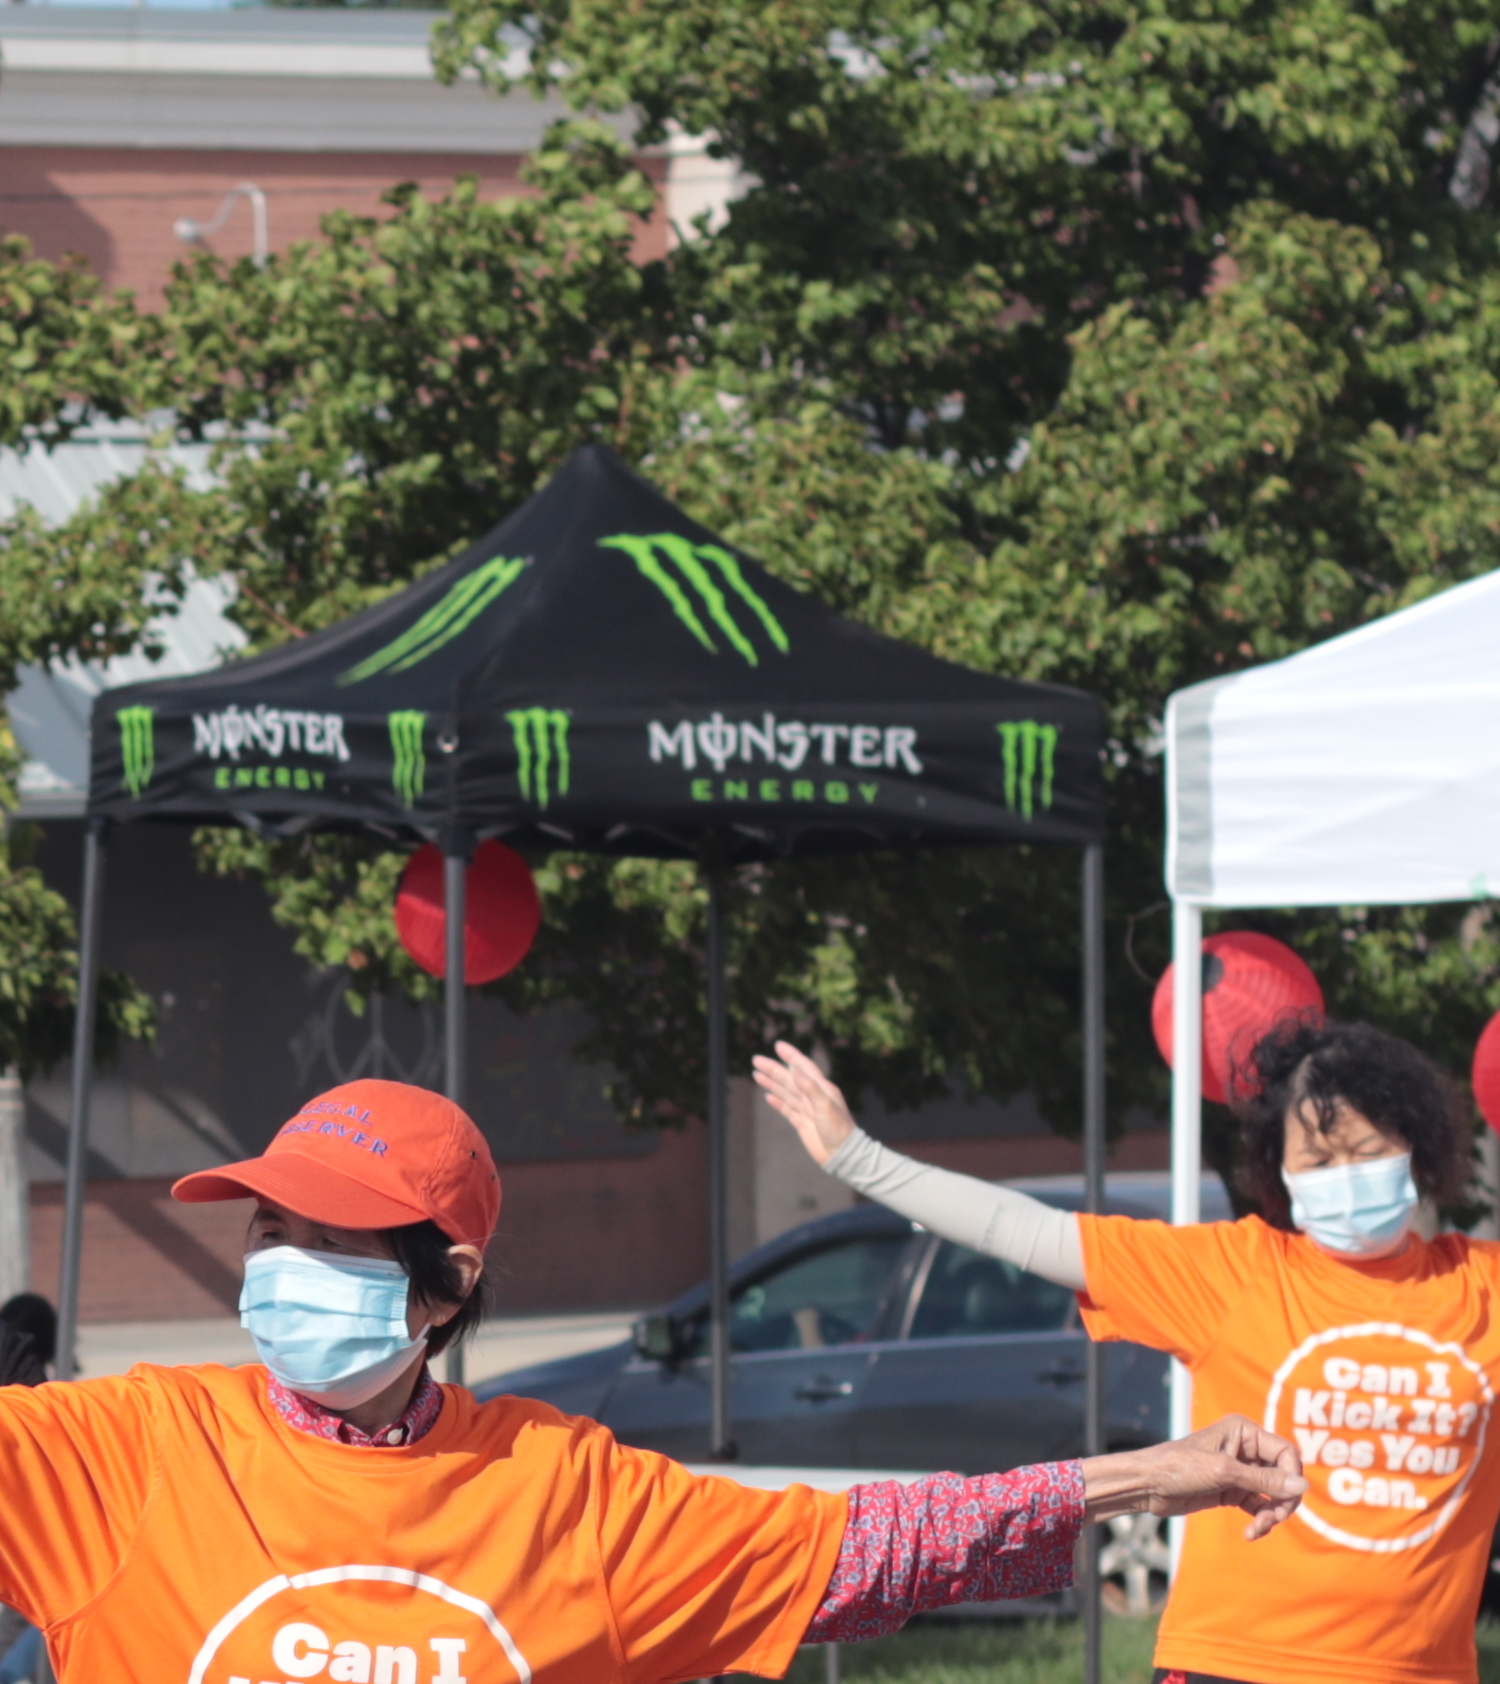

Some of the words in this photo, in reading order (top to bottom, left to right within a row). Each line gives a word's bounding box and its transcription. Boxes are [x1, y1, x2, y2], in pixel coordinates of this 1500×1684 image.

[191, 703, 351, 763] MONSTER
[648, 711, 924, 776] MONSTER
[214, 766, 326, 791] ENERGY
[690, 779, 879, 804] ENERGY
[300, 1102, 372, 1126] LEGAL
[1323, 1357, 1418, 1396] Can
[1425, 1362, 1452, 1398] I
[1293, 1388, 1403, 1431] Kick
[1407, 1399, 1478, 1437] It?
[1293, 1427, 1375, 1469] Yes
[1379, 1433, 1460, 1475] You
[1327, 1467, 1428, 1511] Can.
